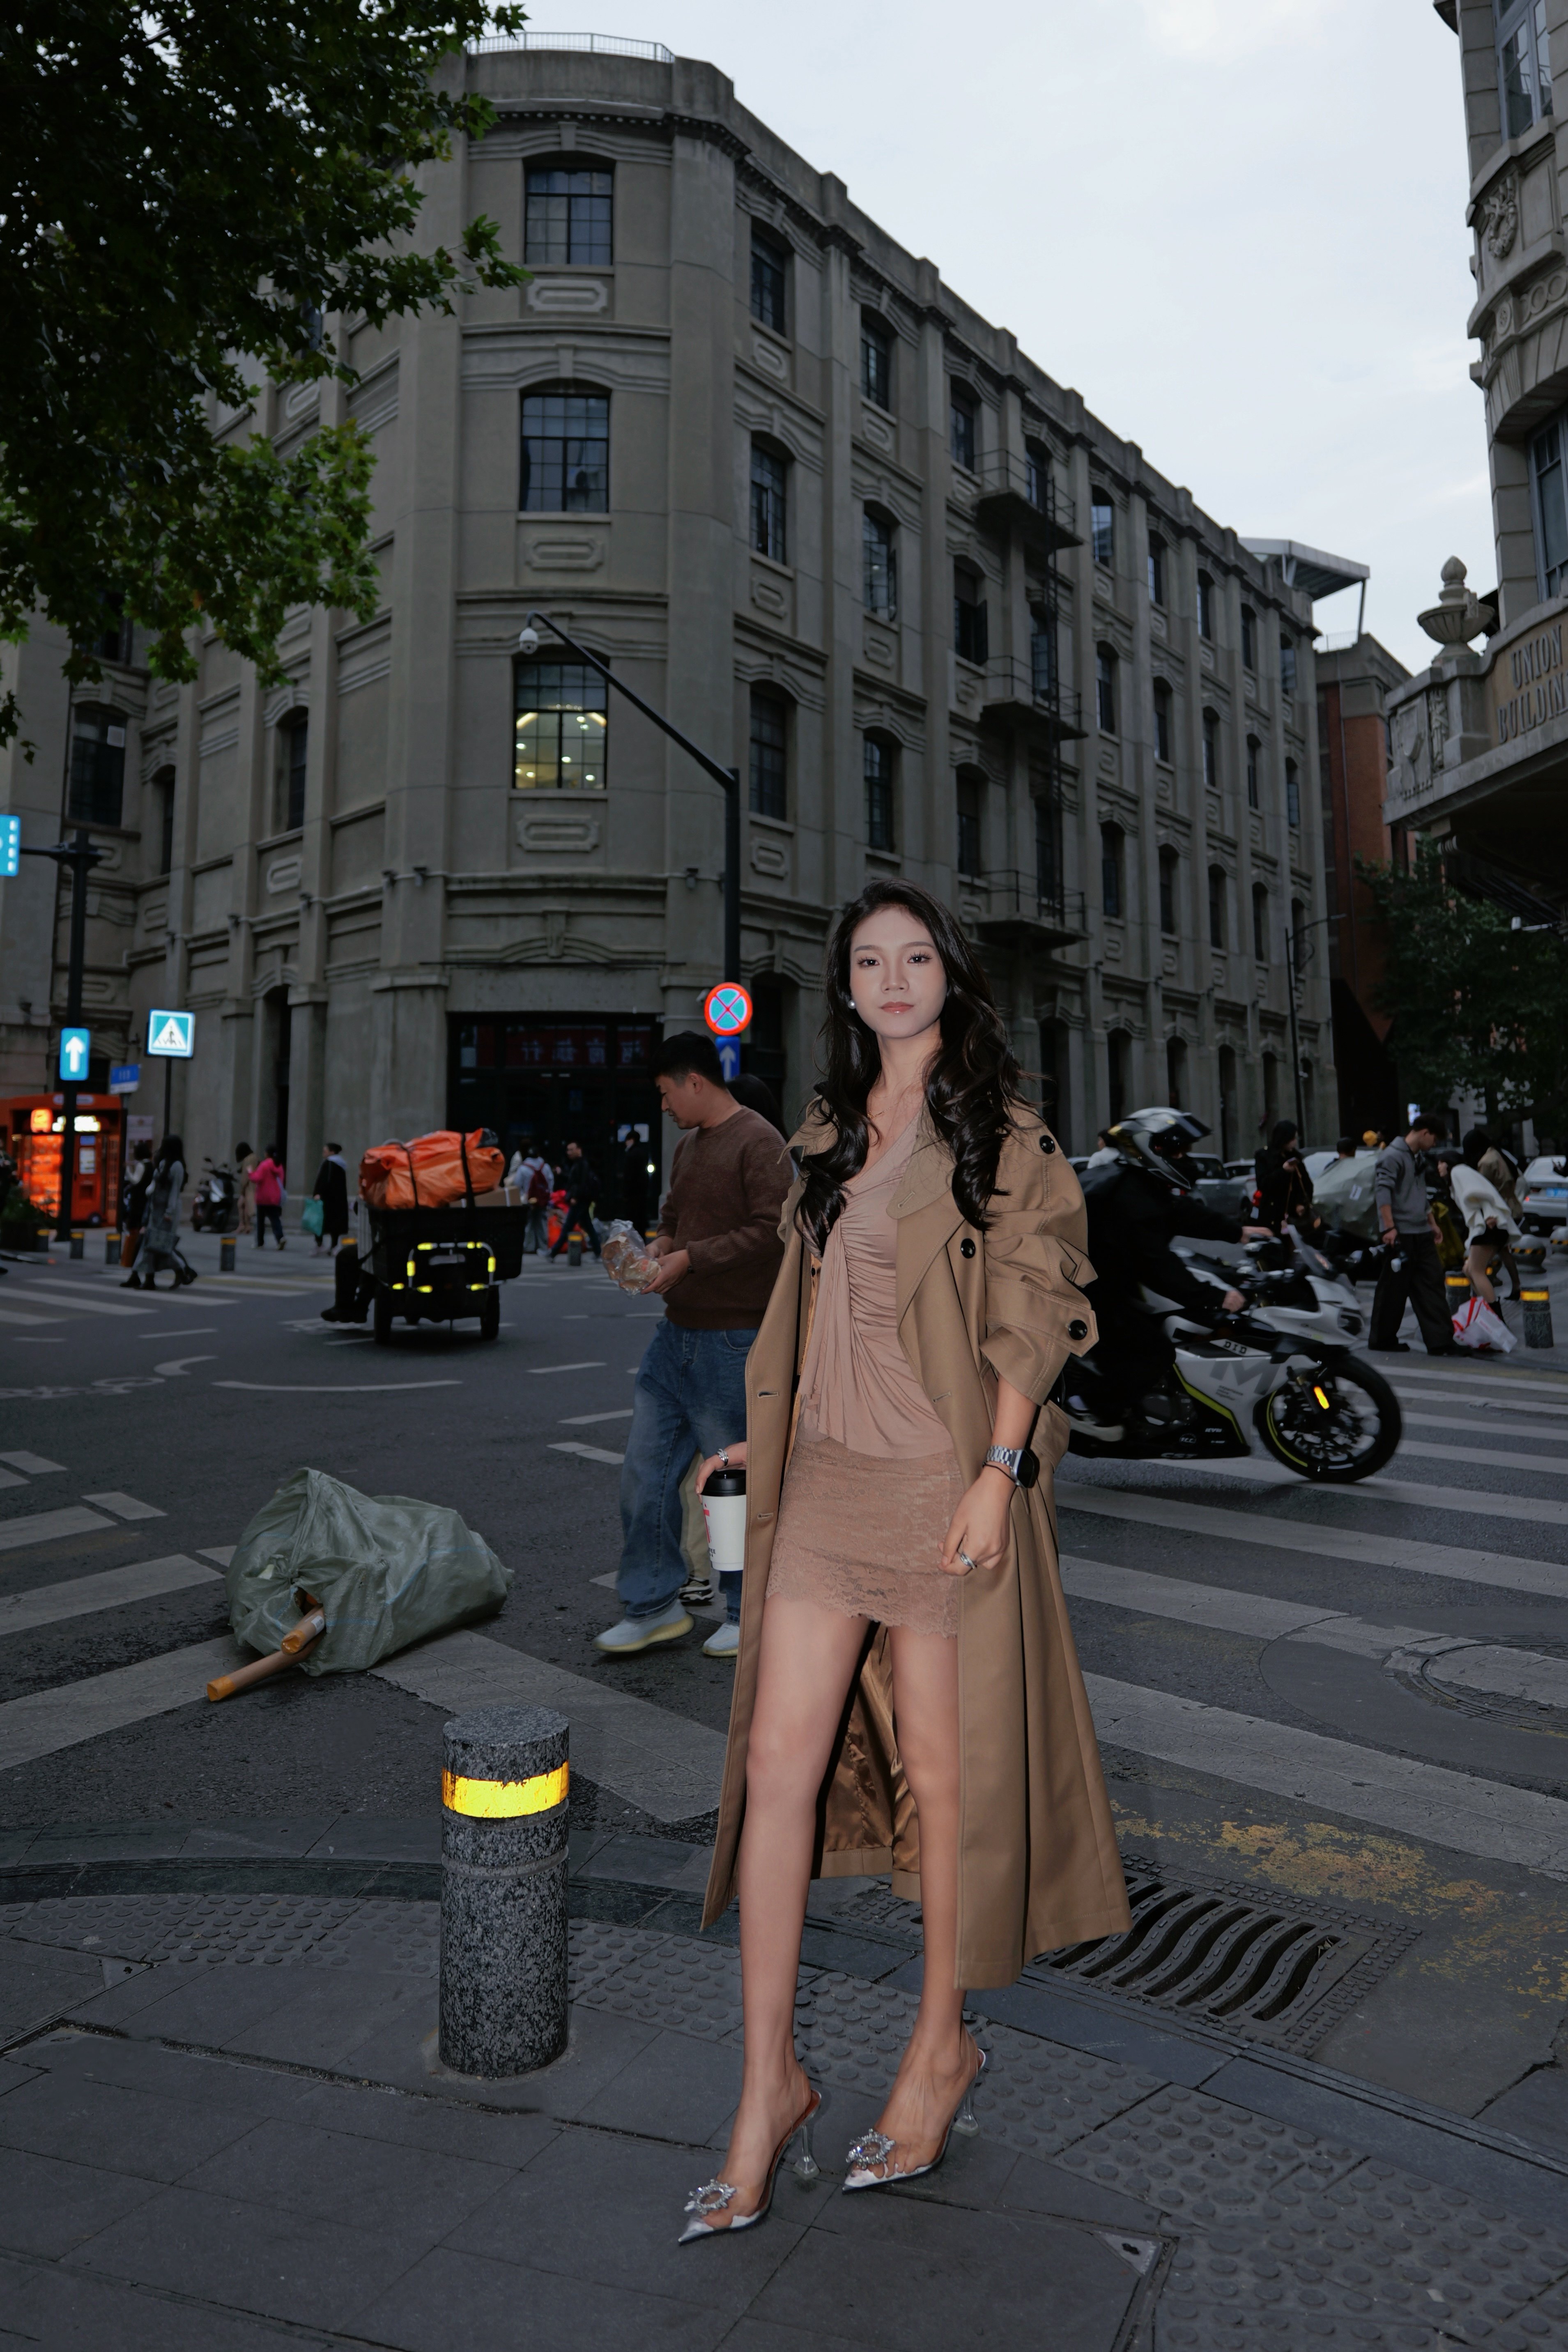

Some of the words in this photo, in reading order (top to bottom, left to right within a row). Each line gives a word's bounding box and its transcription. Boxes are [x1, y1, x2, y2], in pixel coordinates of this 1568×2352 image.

[1511, 624, 1563, 689] UNION
[1497, 670, 1568, 744] BUILDIN
[1223, 1341, 1247, 1354] DID
